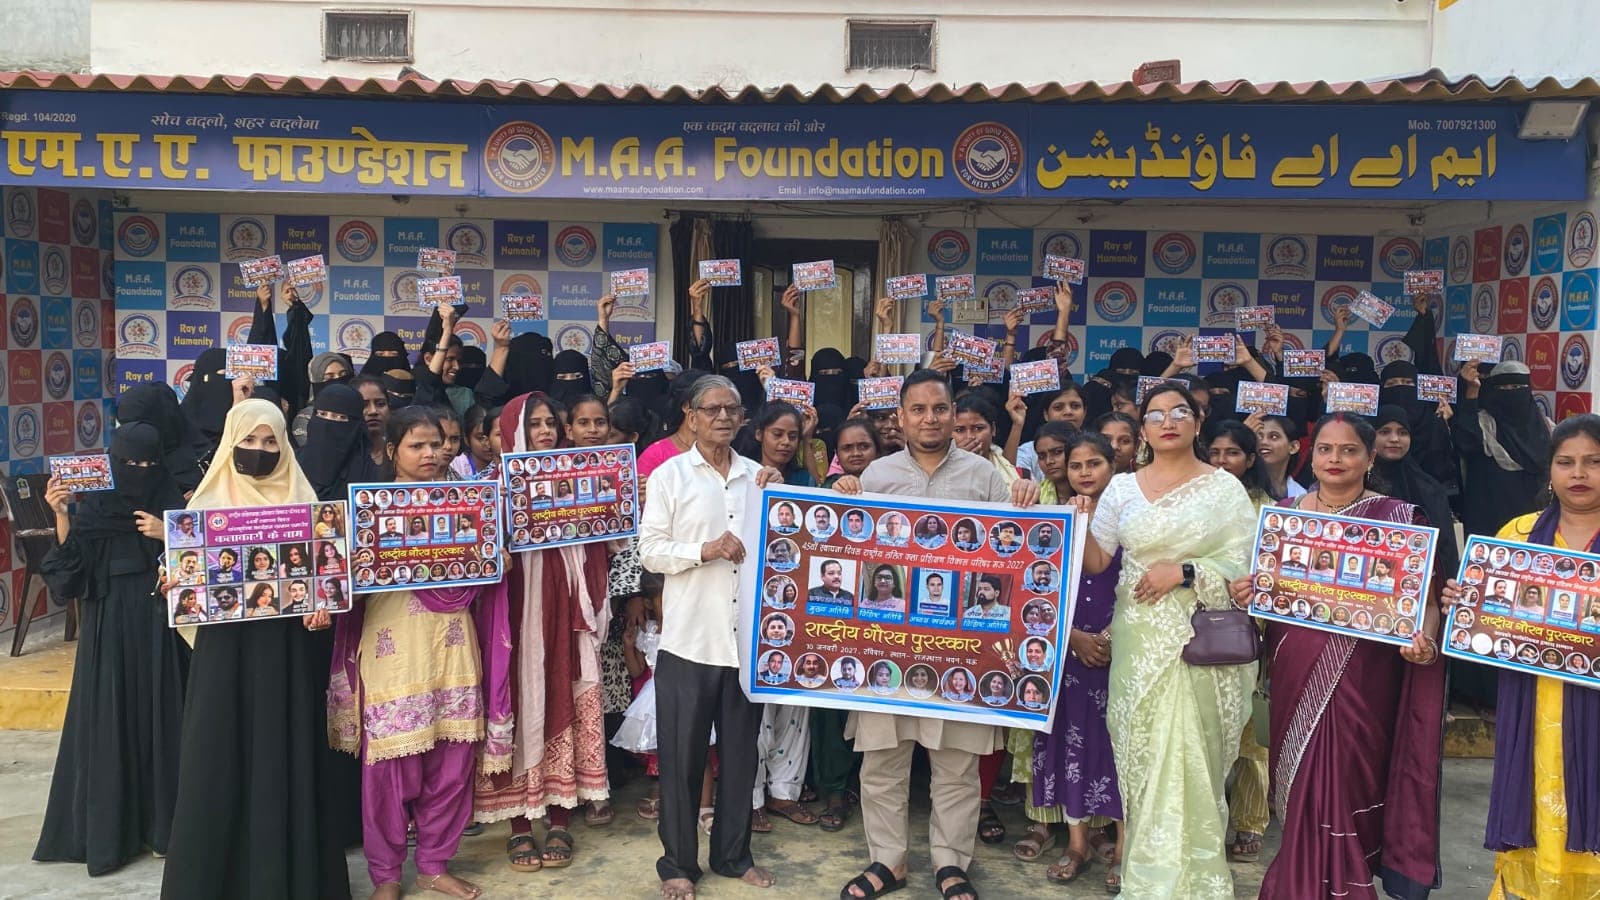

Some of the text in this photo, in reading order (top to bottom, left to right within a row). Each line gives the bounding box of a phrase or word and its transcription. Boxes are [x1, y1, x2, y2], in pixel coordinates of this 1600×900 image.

[1, 112, 76, 123] Regd. 104/2020
[151, 113, 319, 131] सोच बदलो, शहर बदलेगा
[683, 118, 825, 134] एक कदम बदलाव की ओर
[1408, 120, 1497, 130] Mob. 7007921300
[232, 126, 469, 188] फाउण्डेशन
[561, 137, 944, 180] M.A.A. Foundation
[1036, 121, 1497, 192] ایم اے اے فاؤنڈیشن
[584, 184, 704, 194] www.maamaufoundation.com
[779, 186, 801, 194] Email
[180, 226, 207, 236] M.A.A.
[288, 228, 315, 239] Ray of
[170, 238, 217, 249] Foundation
[507, 234, 535, 245] Ray of
[616, 236, 644, 246] M.A.A.
[991, 240, 1018, 249] M.A.A.
[282, 241, 322, 253] Humanity
[501, 246, 541, 258] Humanity
[1103, 241, 1132, 252] Ray of
[1217, 242, 1245, 252] M.A.A.
[1330, 244, 1359, 255] Ray of
[607, 248, 654, 259] Foundation
[981, 252, 1029, 262] Foundation
[1097, 254, 1138, 265] Humanity
[1207, 254, 1256, 265] Foundation
[1324, 257, 1365, 268] Humanity
[125, 274, 152, 284] M.A.A.
[343, 279, 371, 288] M.A.A.
[116, 286, 162, 296] Foundation
[561, 284, 589, 294] M.A.A.
[334, 291, 380, 302] Foundation
[1158, 290, 1187, 300] M.A.A.
[1272, 292, 1300, 303] Ray of
[552, 296, 599, 307] Foundation
[1148, 302, 1196, 313] Foundation
[180, 324, 207, 334] Ray of
[397, 329, 426, 339] Ray of
[173, 336, 214, 347] Humanity
[615, 334, 643, 345] Ray of
[125, 371, 153, 382] Ray of
[1481, 615, 1513, 630] राष्ट्रीय
[1546, 629, 1594, 646] पुरस्कार
[805, 620, 982, 654] राष्ट्रीय गौरव पुरस्कार
